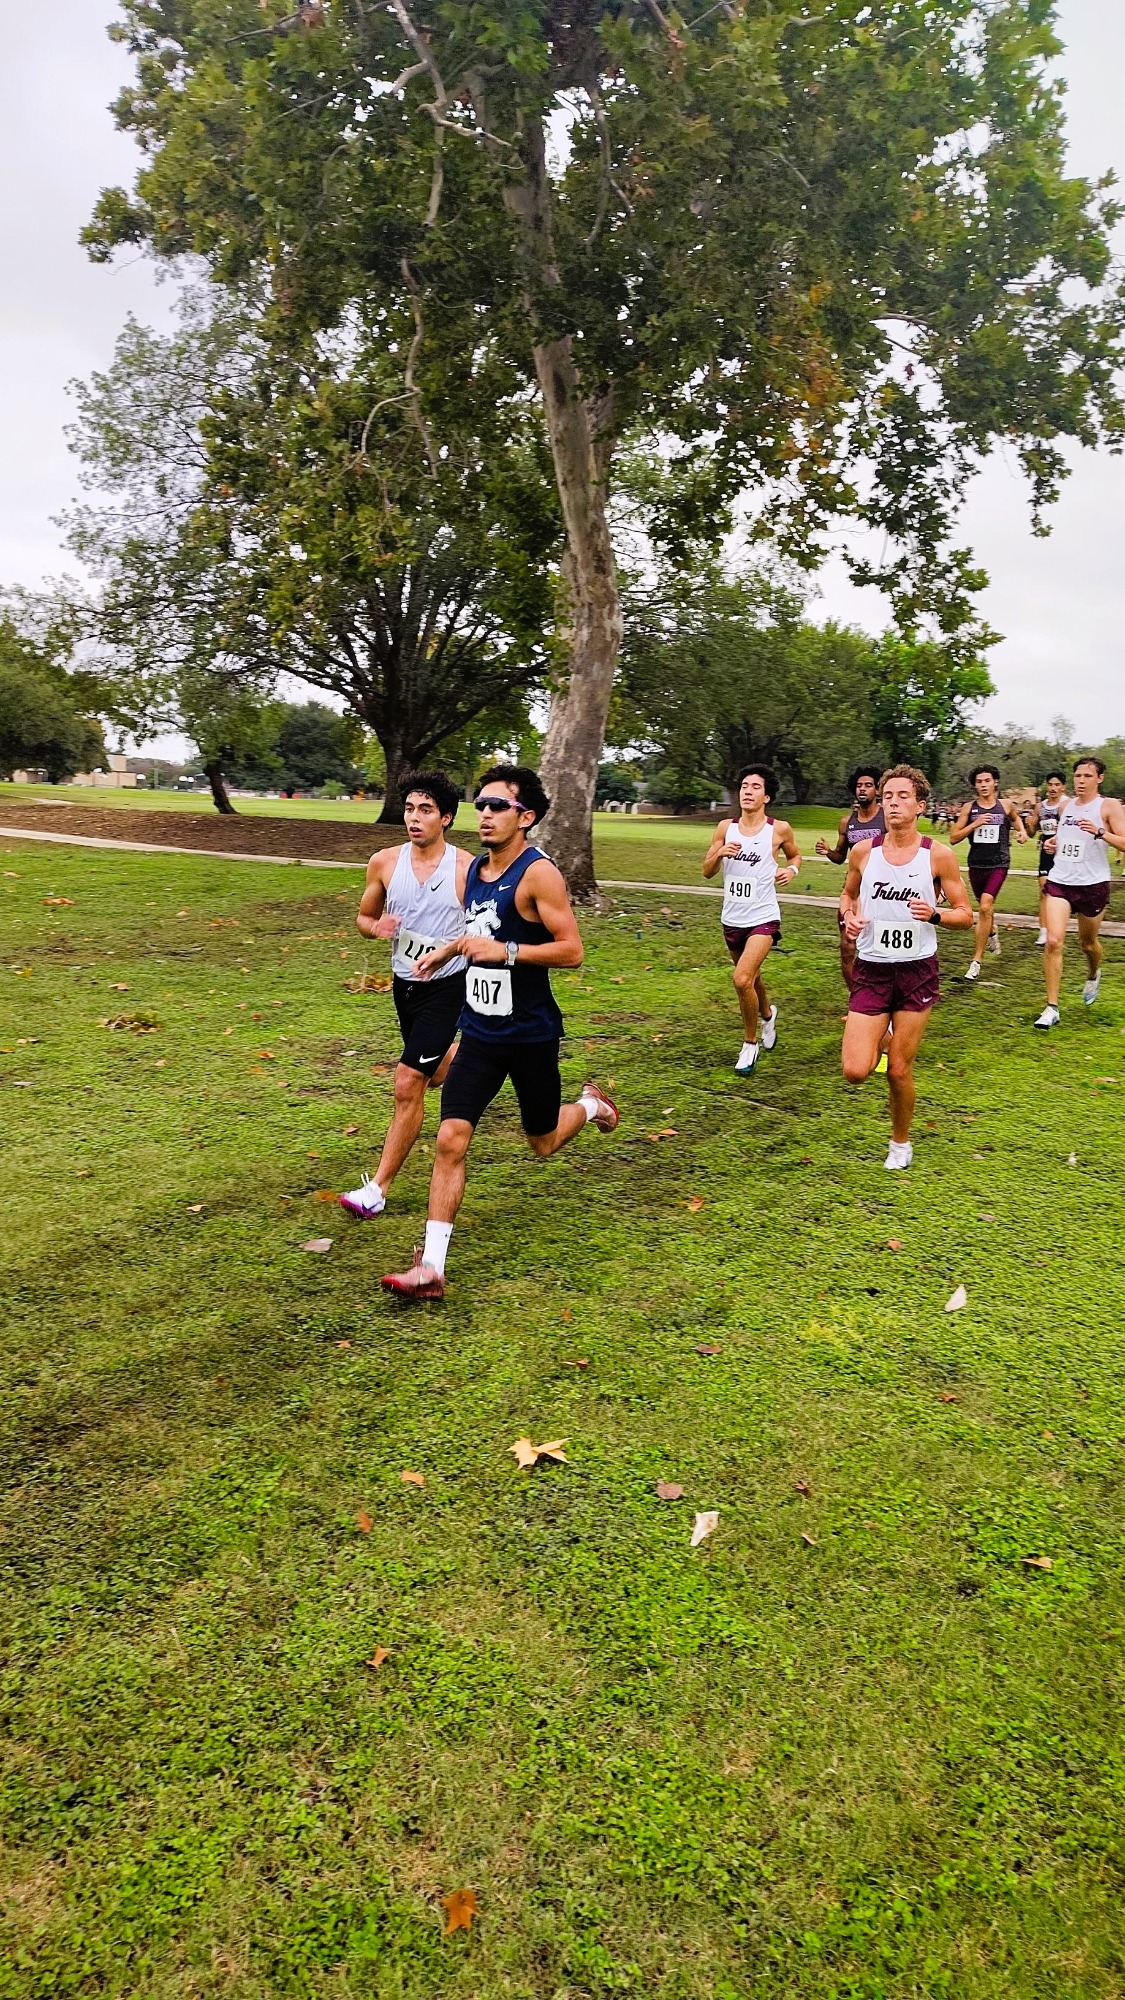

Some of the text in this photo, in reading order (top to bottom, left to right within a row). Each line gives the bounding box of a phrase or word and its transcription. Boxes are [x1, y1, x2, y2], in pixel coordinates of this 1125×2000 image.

[977, 828, 995, 839] 419
[1061, 843, 1080, 858] 495
[729, 881, 751, 898] 490
[880, 929, 913, 949] 488
[472, 978, 502, 1005] 407
